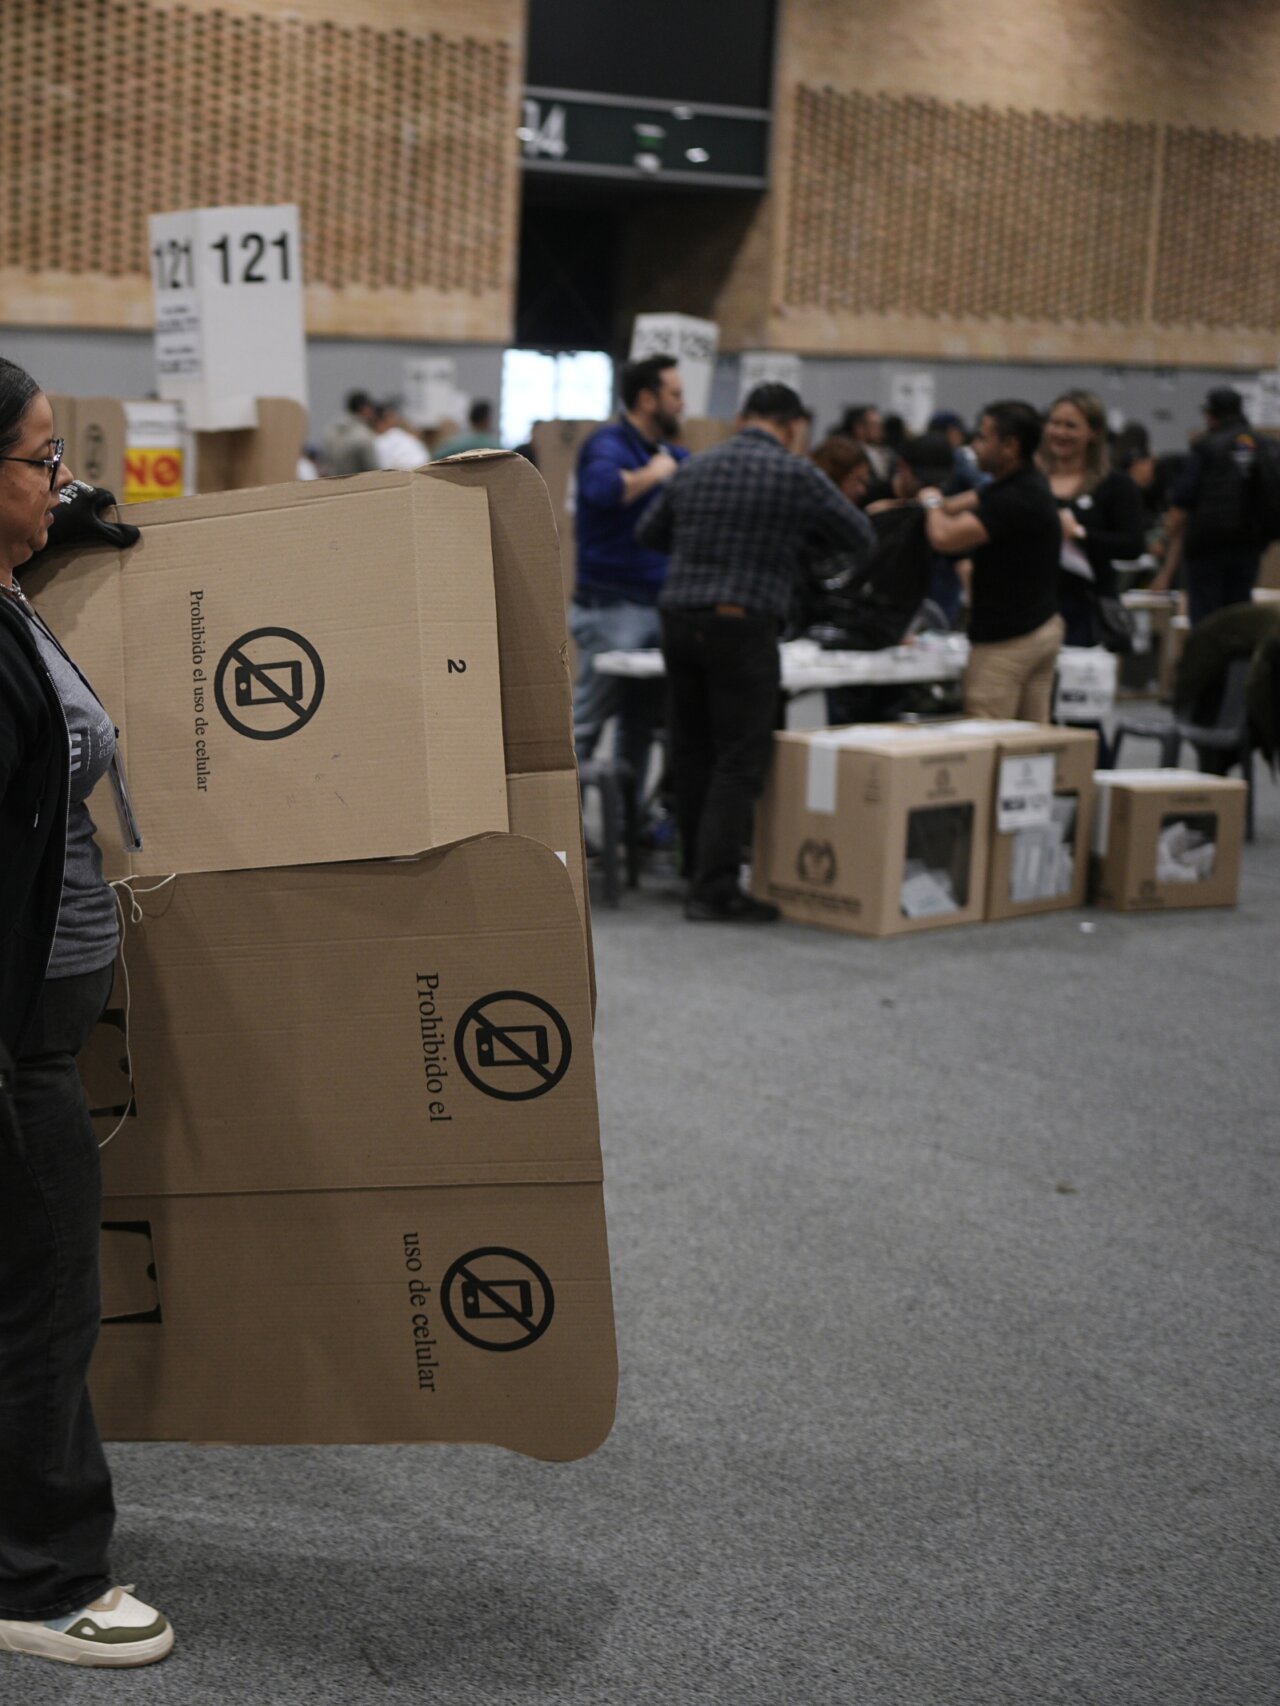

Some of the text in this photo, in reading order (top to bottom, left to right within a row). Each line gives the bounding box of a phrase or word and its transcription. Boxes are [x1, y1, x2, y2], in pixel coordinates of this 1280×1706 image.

[154, 237, 195, 290] 121
[210, 230, 291, 285] 121
[122, 454, 181, 488] NO
[190, 590, 211, 792] Prohibido el uso de celular
[447, 659, 467, 673] 2
[416, 972, 452, 1123] Prohibido el
[403, 1232, 439, 1392] uso de celular
